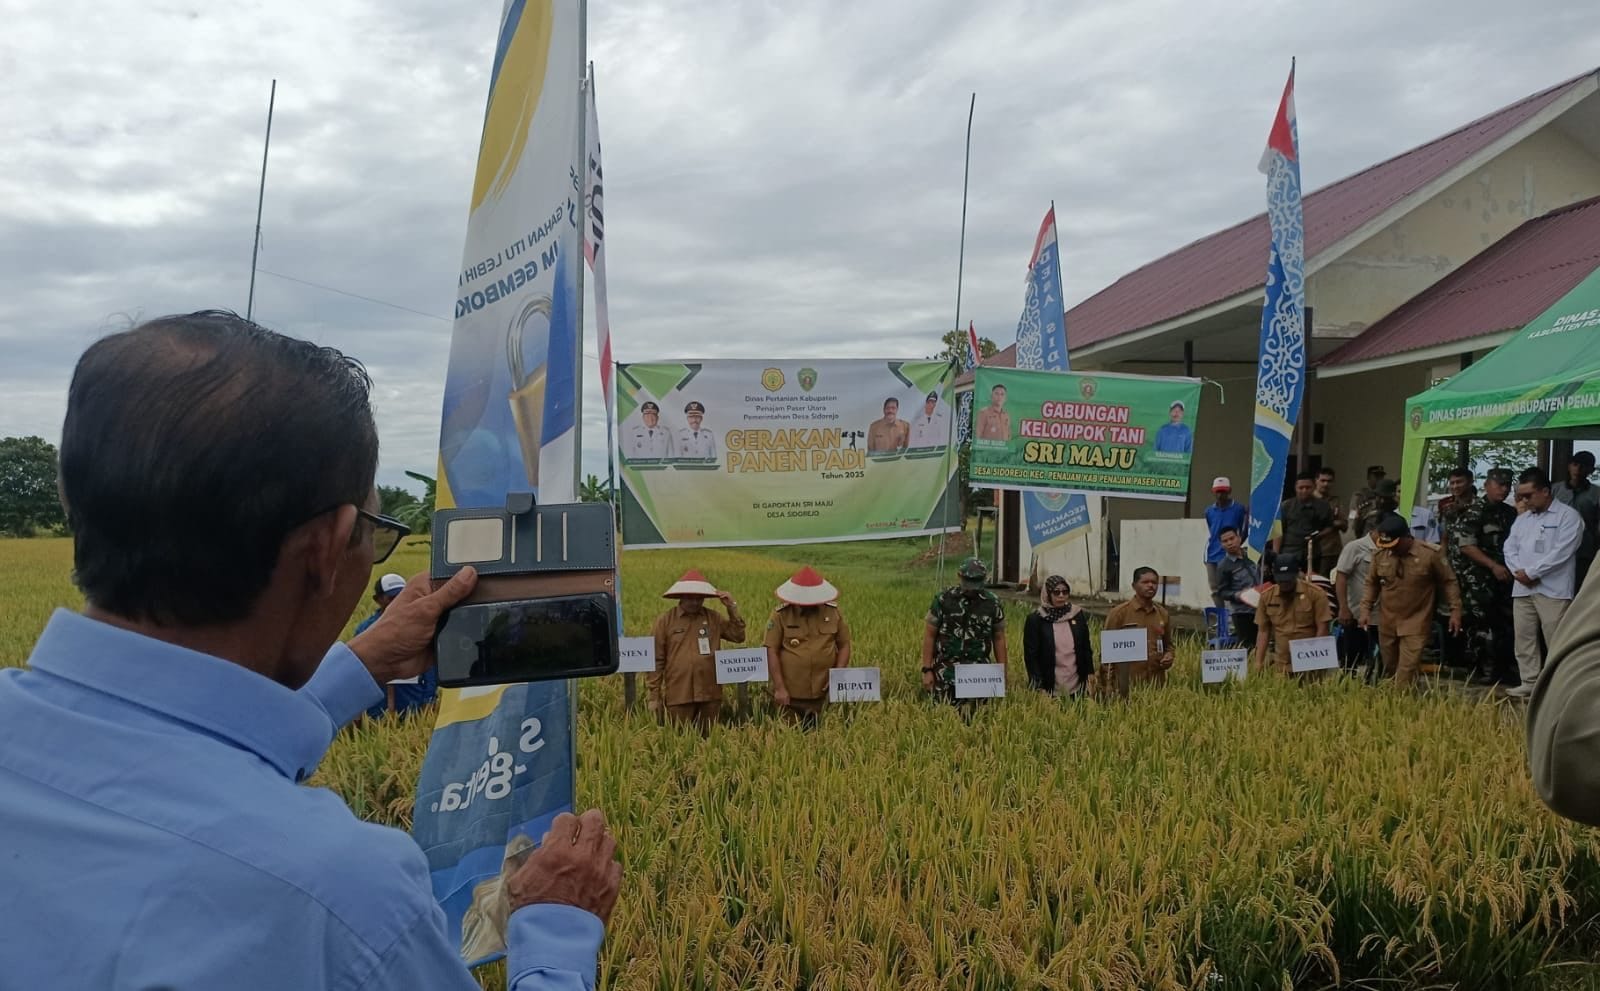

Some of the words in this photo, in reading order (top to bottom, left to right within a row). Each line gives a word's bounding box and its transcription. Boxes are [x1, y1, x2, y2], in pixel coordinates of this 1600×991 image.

[1553, 309, 1599, 327] DINAS
[756, 405, 784, 413] Penajam
[1042, 401, 1129, 423] GABUNGAN
[1429, 407, 1455, 422] DINAS
[1456, 403, 1507, 419] PERTANIAN
[1507, 397, 1565, 416] KABUPATEN
[811, 413, 839, 421] Sidorejo
[1020, 420, 1106, 442] KELOMPOK
[1109, 426, 1145, 445] TANI
[725, 428, 841, 451] GERAKAN
[726, 450, 807, 473] PANEN
[812, 448, 866, 472] PADI
[1024, 441, 1065, 464] SRI
[1068, 444, 1137, 470] MAJU
[821, 472, 843, 480] Tahun
[845, 471, 865, 479] 2025
[975, 465, 991, 475] DESA
[993, 467, 1028, 478] SIDOREJO
[1049, 472, 1082, 481] PENAJAM
[1099, 475, 1132, 485] PENAJAM
[1133, 477, 1155, 486] PASER
[1157, 478, 1181, 488] UTARA
[762, 501, 802, 509] GAPOKTAN
[787, 510, 820, 518] SIDOREJO
[1112, 641, 1136, 649] DPRD
[1297, 649, 1330, 660] CAMAT
[720, 657, 763, 665] SEKRETARIS
[837, 681, 873, 691] BUPATI
[958, 677, 987, 685] DANDIM
